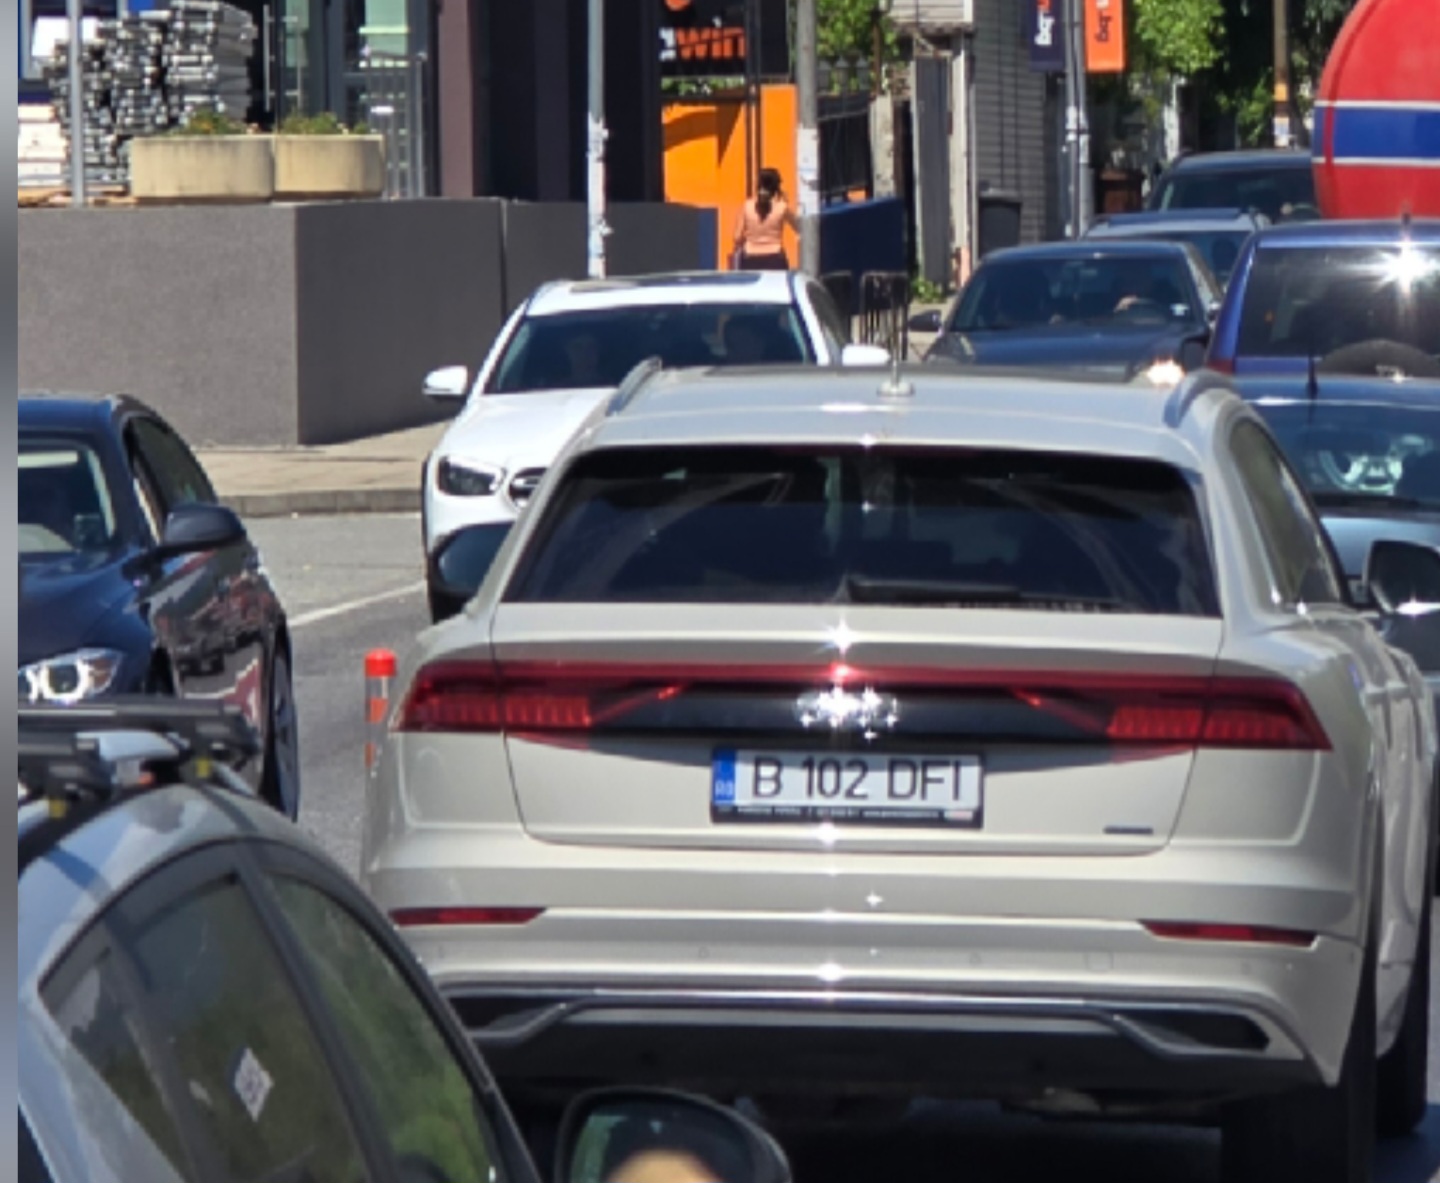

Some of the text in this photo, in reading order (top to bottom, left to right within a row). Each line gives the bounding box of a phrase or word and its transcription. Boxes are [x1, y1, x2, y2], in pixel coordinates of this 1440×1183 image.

[753, 756, 961, 801] B 102 DFI
